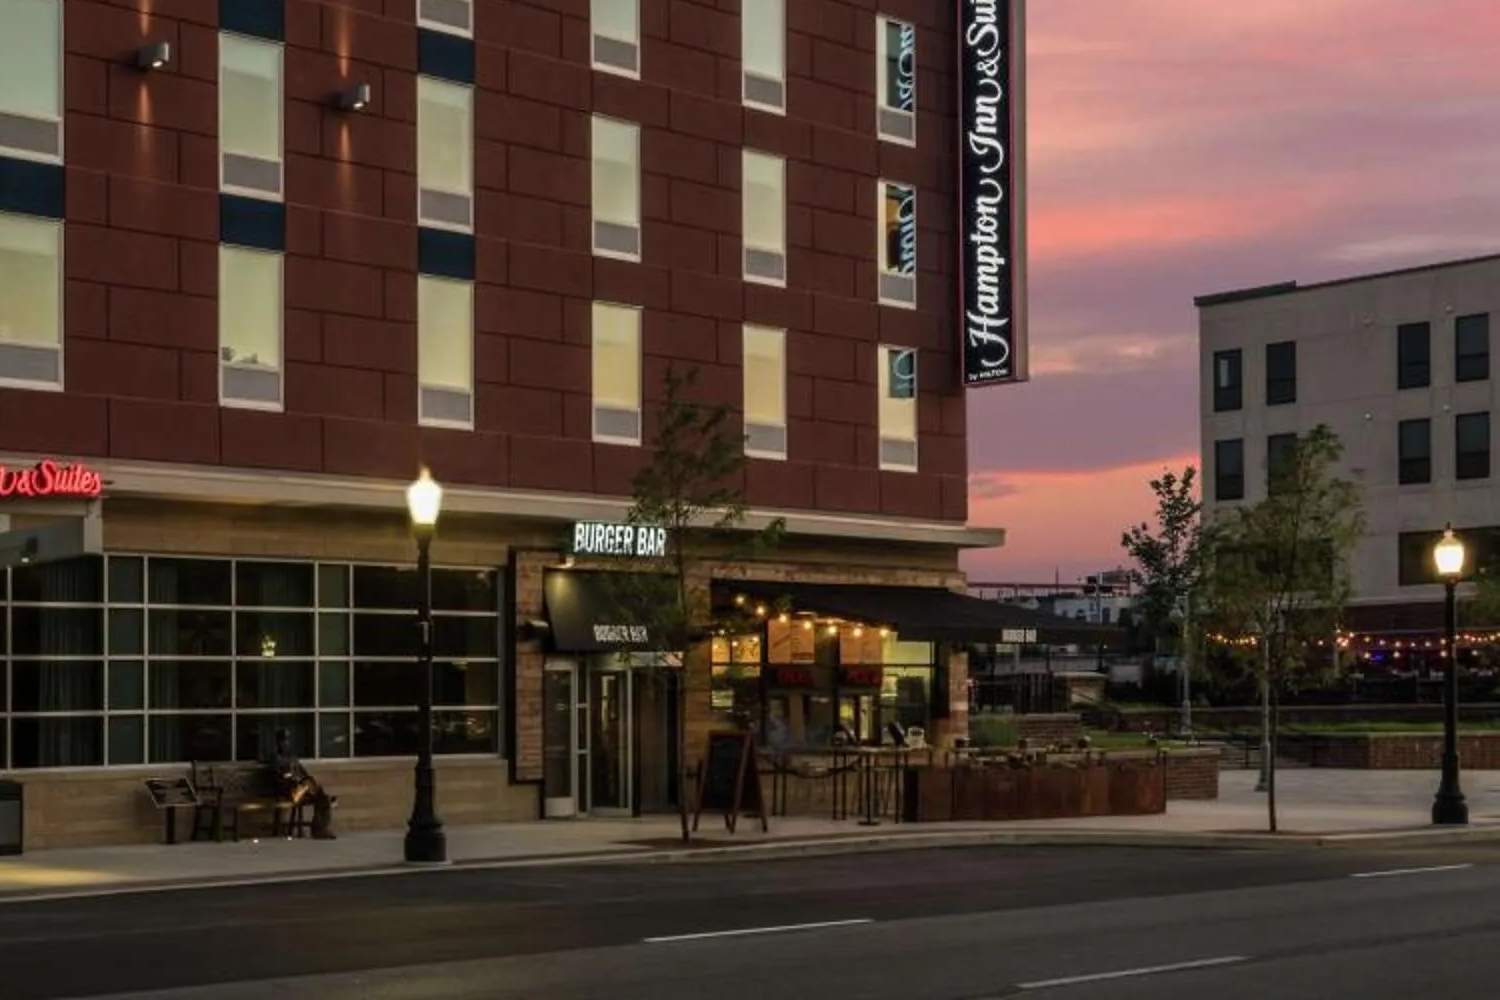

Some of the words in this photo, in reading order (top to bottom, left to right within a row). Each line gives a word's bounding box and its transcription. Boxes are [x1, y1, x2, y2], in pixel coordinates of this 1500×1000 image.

[968, 78, 1004, 174] Inn
[970, 178, 1010, 368] Hampton
[31, 460, 101, 497] Suites
[574, 522, 633, 554] BURGER
[637, 527, 667, 557] BAR
